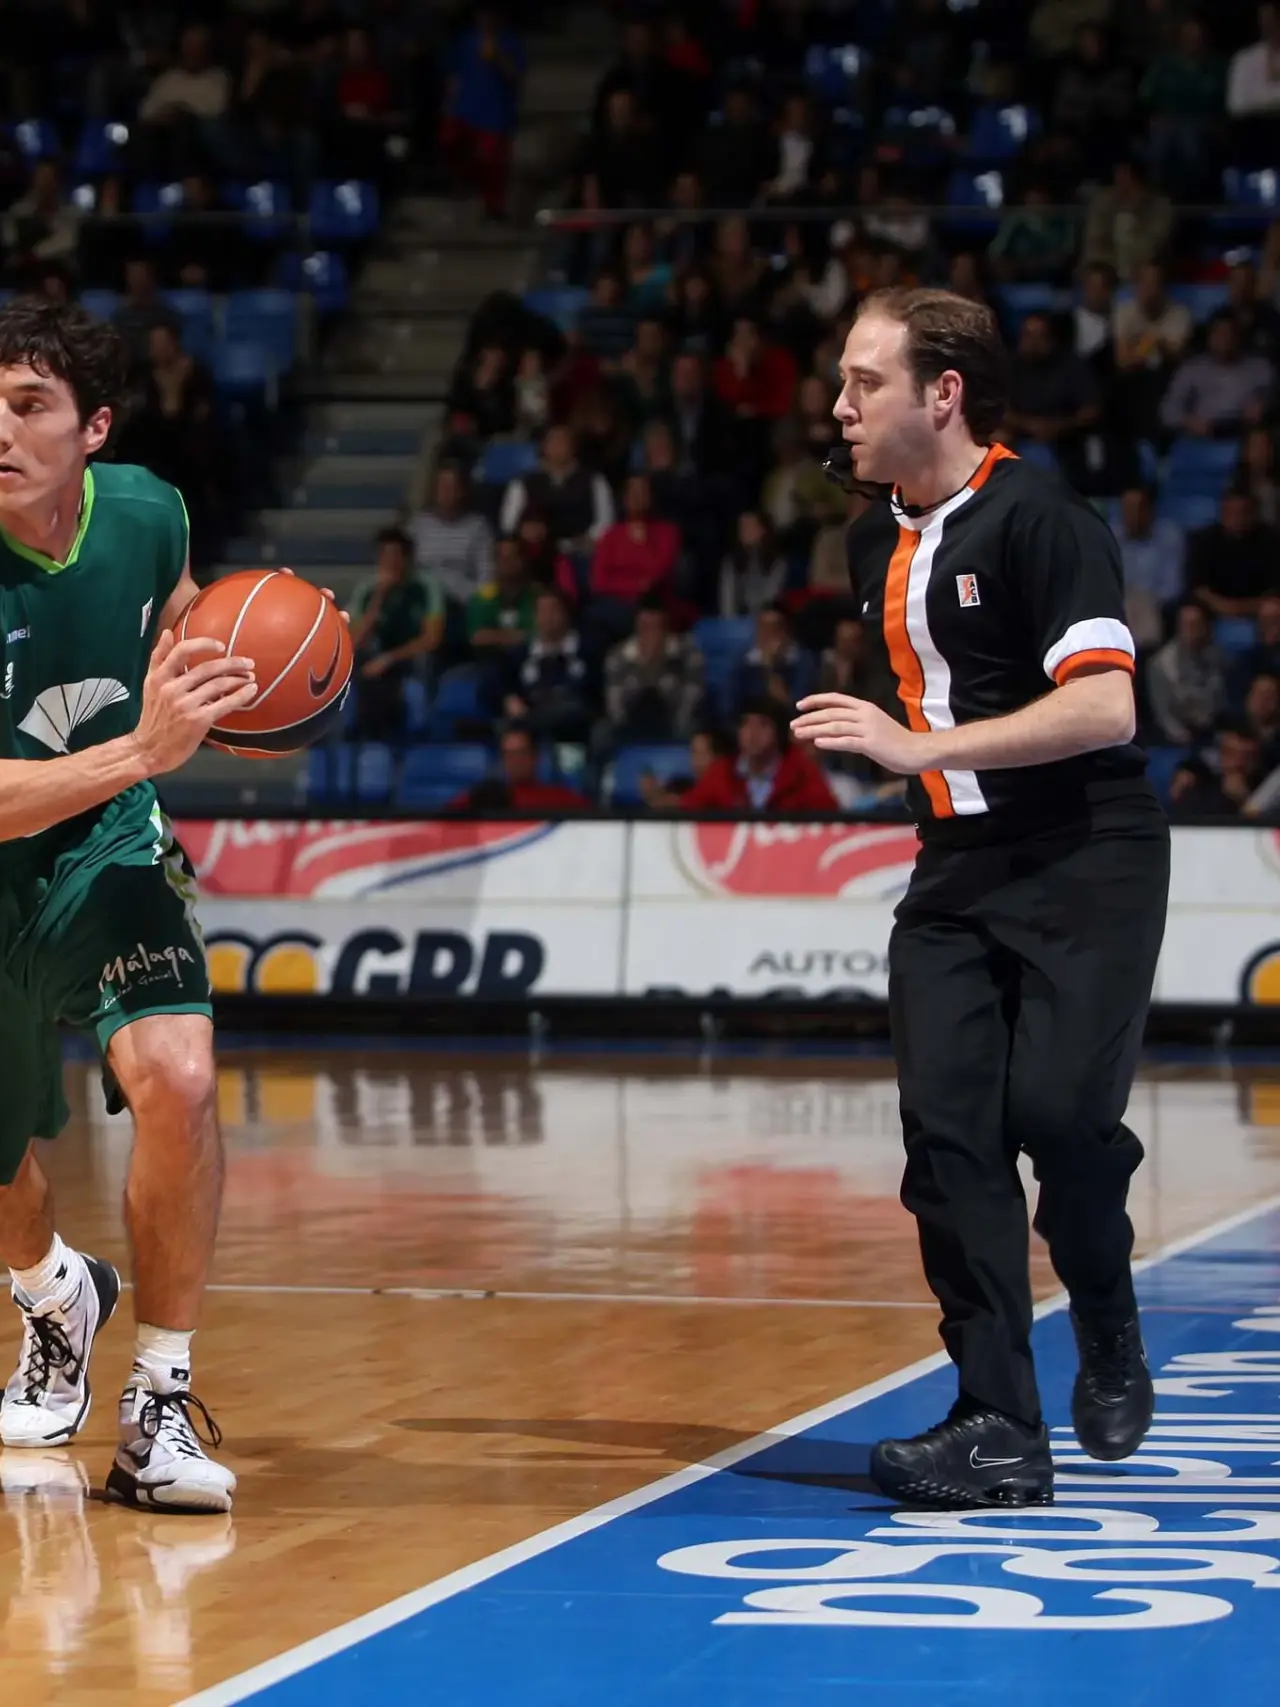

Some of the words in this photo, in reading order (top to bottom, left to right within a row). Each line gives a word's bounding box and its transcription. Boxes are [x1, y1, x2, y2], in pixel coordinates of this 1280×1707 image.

[969, 580, 978, 604] ACB
[98, 943, 195, 993] Málaga
[746, 948, 888, 978] AUTO
